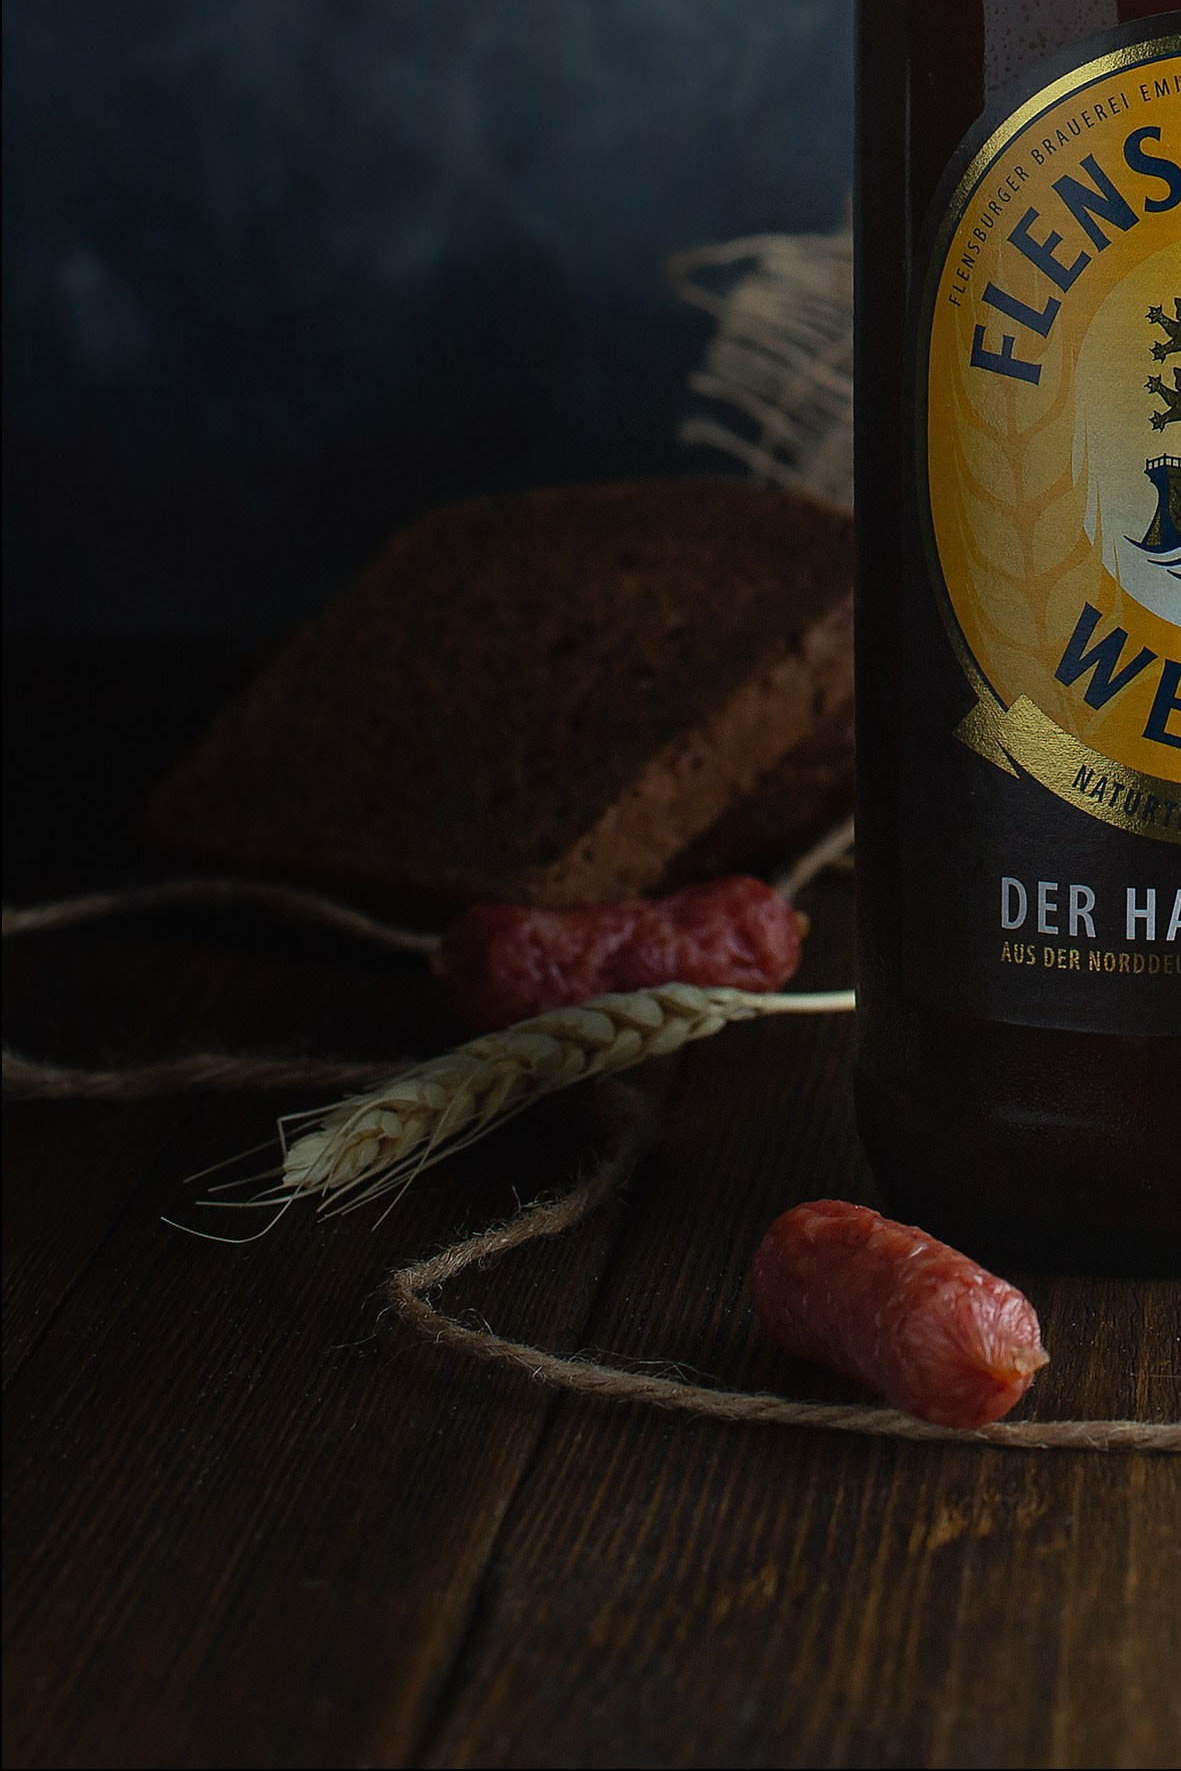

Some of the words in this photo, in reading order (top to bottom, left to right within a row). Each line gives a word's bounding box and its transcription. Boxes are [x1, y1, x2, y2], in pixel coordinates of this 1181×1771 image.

[948, 164, 1030, 308] FLENSBURGER
[1030, 92, 1130, 166] BRAUEREI
[1000, 876, 1097, 938] DER
[1000, 940, 1037, 966] AUS
[1043, 946, 1081, 970] DER
